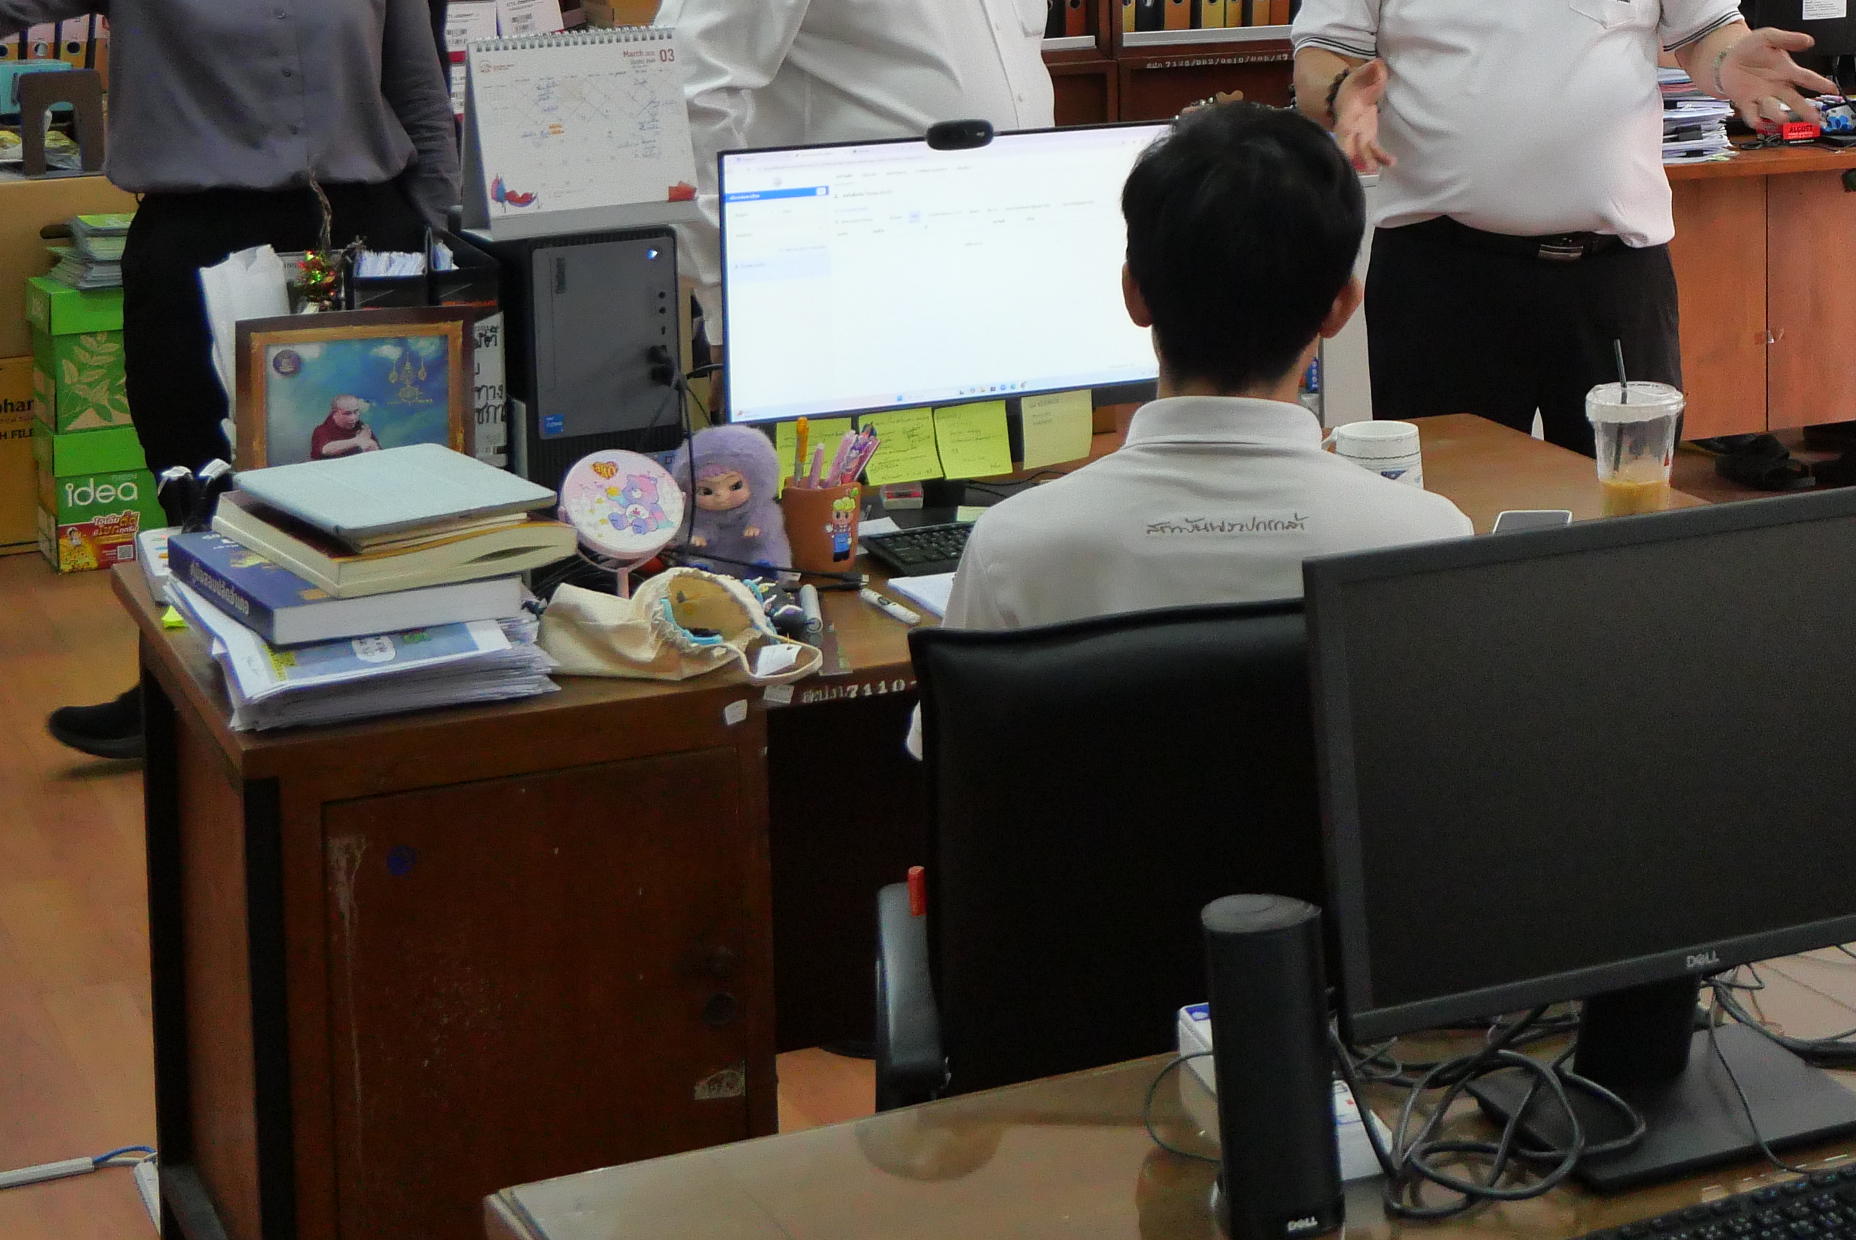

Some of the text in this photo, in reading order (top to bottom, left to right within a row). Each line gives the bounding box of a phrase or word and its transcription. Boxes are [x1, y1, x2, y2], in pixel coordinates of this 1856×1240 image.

[623, 48, 675, 63] March 03
[65, 477, 139, 508] idea
[1146, 512, 1310, 535] สถาบันพระปกเกล้า
[1686, 949, 1720, 968] DELL
[1286, 1216, 1319, 1233] DELL
